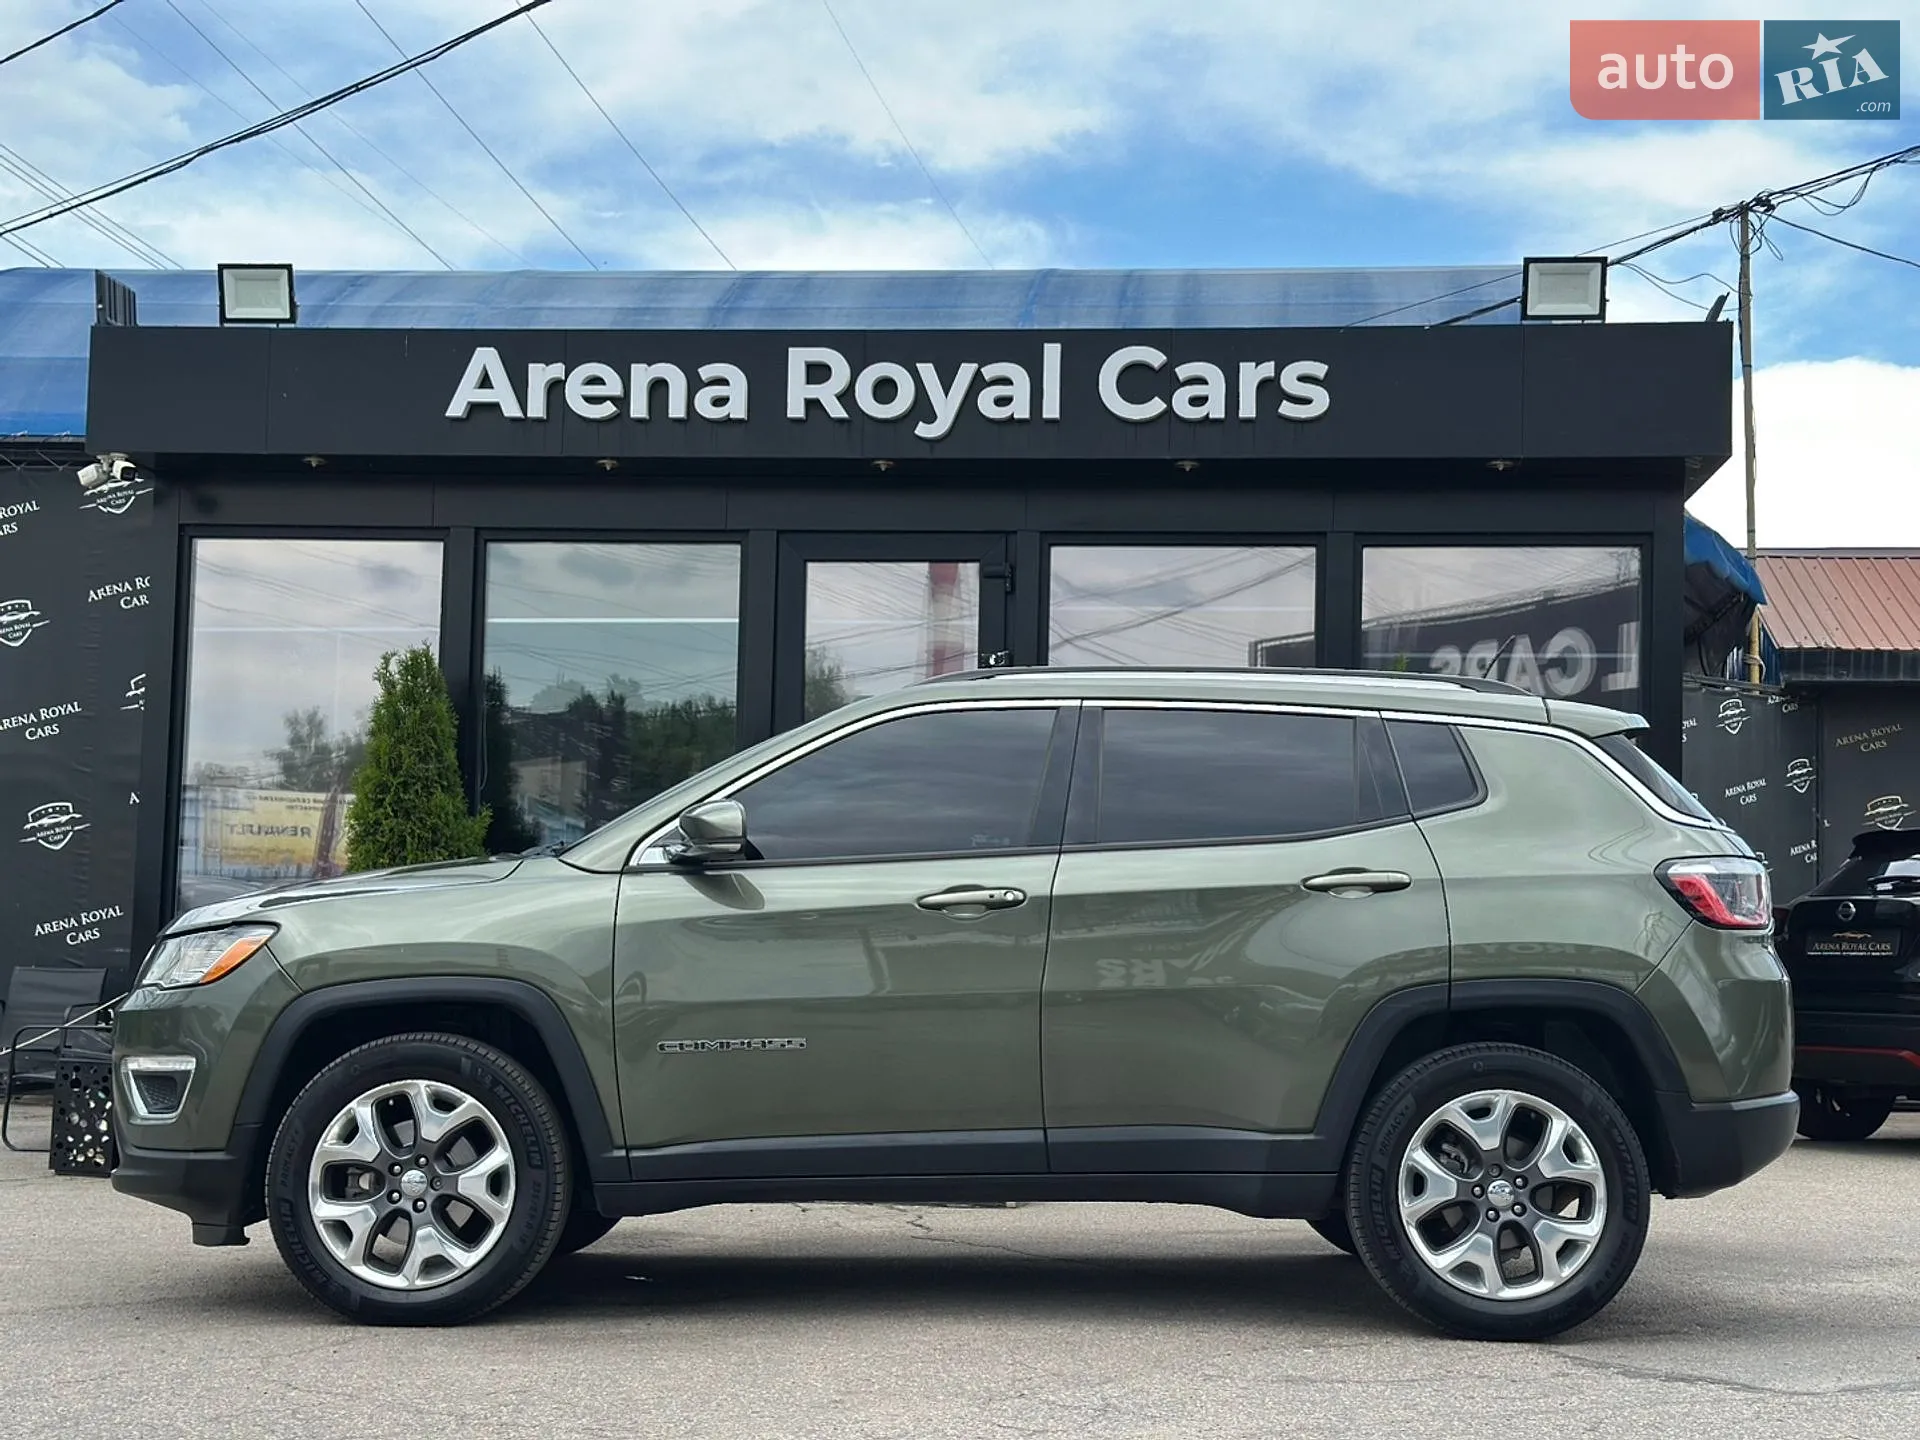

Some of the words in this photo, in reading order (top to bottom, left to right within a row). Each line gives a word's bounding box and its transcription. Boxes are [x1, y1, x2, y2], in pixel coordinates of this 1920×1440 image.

[445, 347, 748, 421] Arena
[786, 342, 1062, 440] Royal
[1098, 345, 1331, 423] Cars
[88, 581, 132, 602] ARENA
[39, 701, 82, 720] ROYAL
[25, 723, 60, 740] CARS
[1860, 739, 1888, 752] CARS
[34, 917, 78, 936] ARENA
[80, 905, 124, 925] ROYAL
[66, 928, 100, 945] CARS
[656, 1037, 807, 1053] COMPASS
